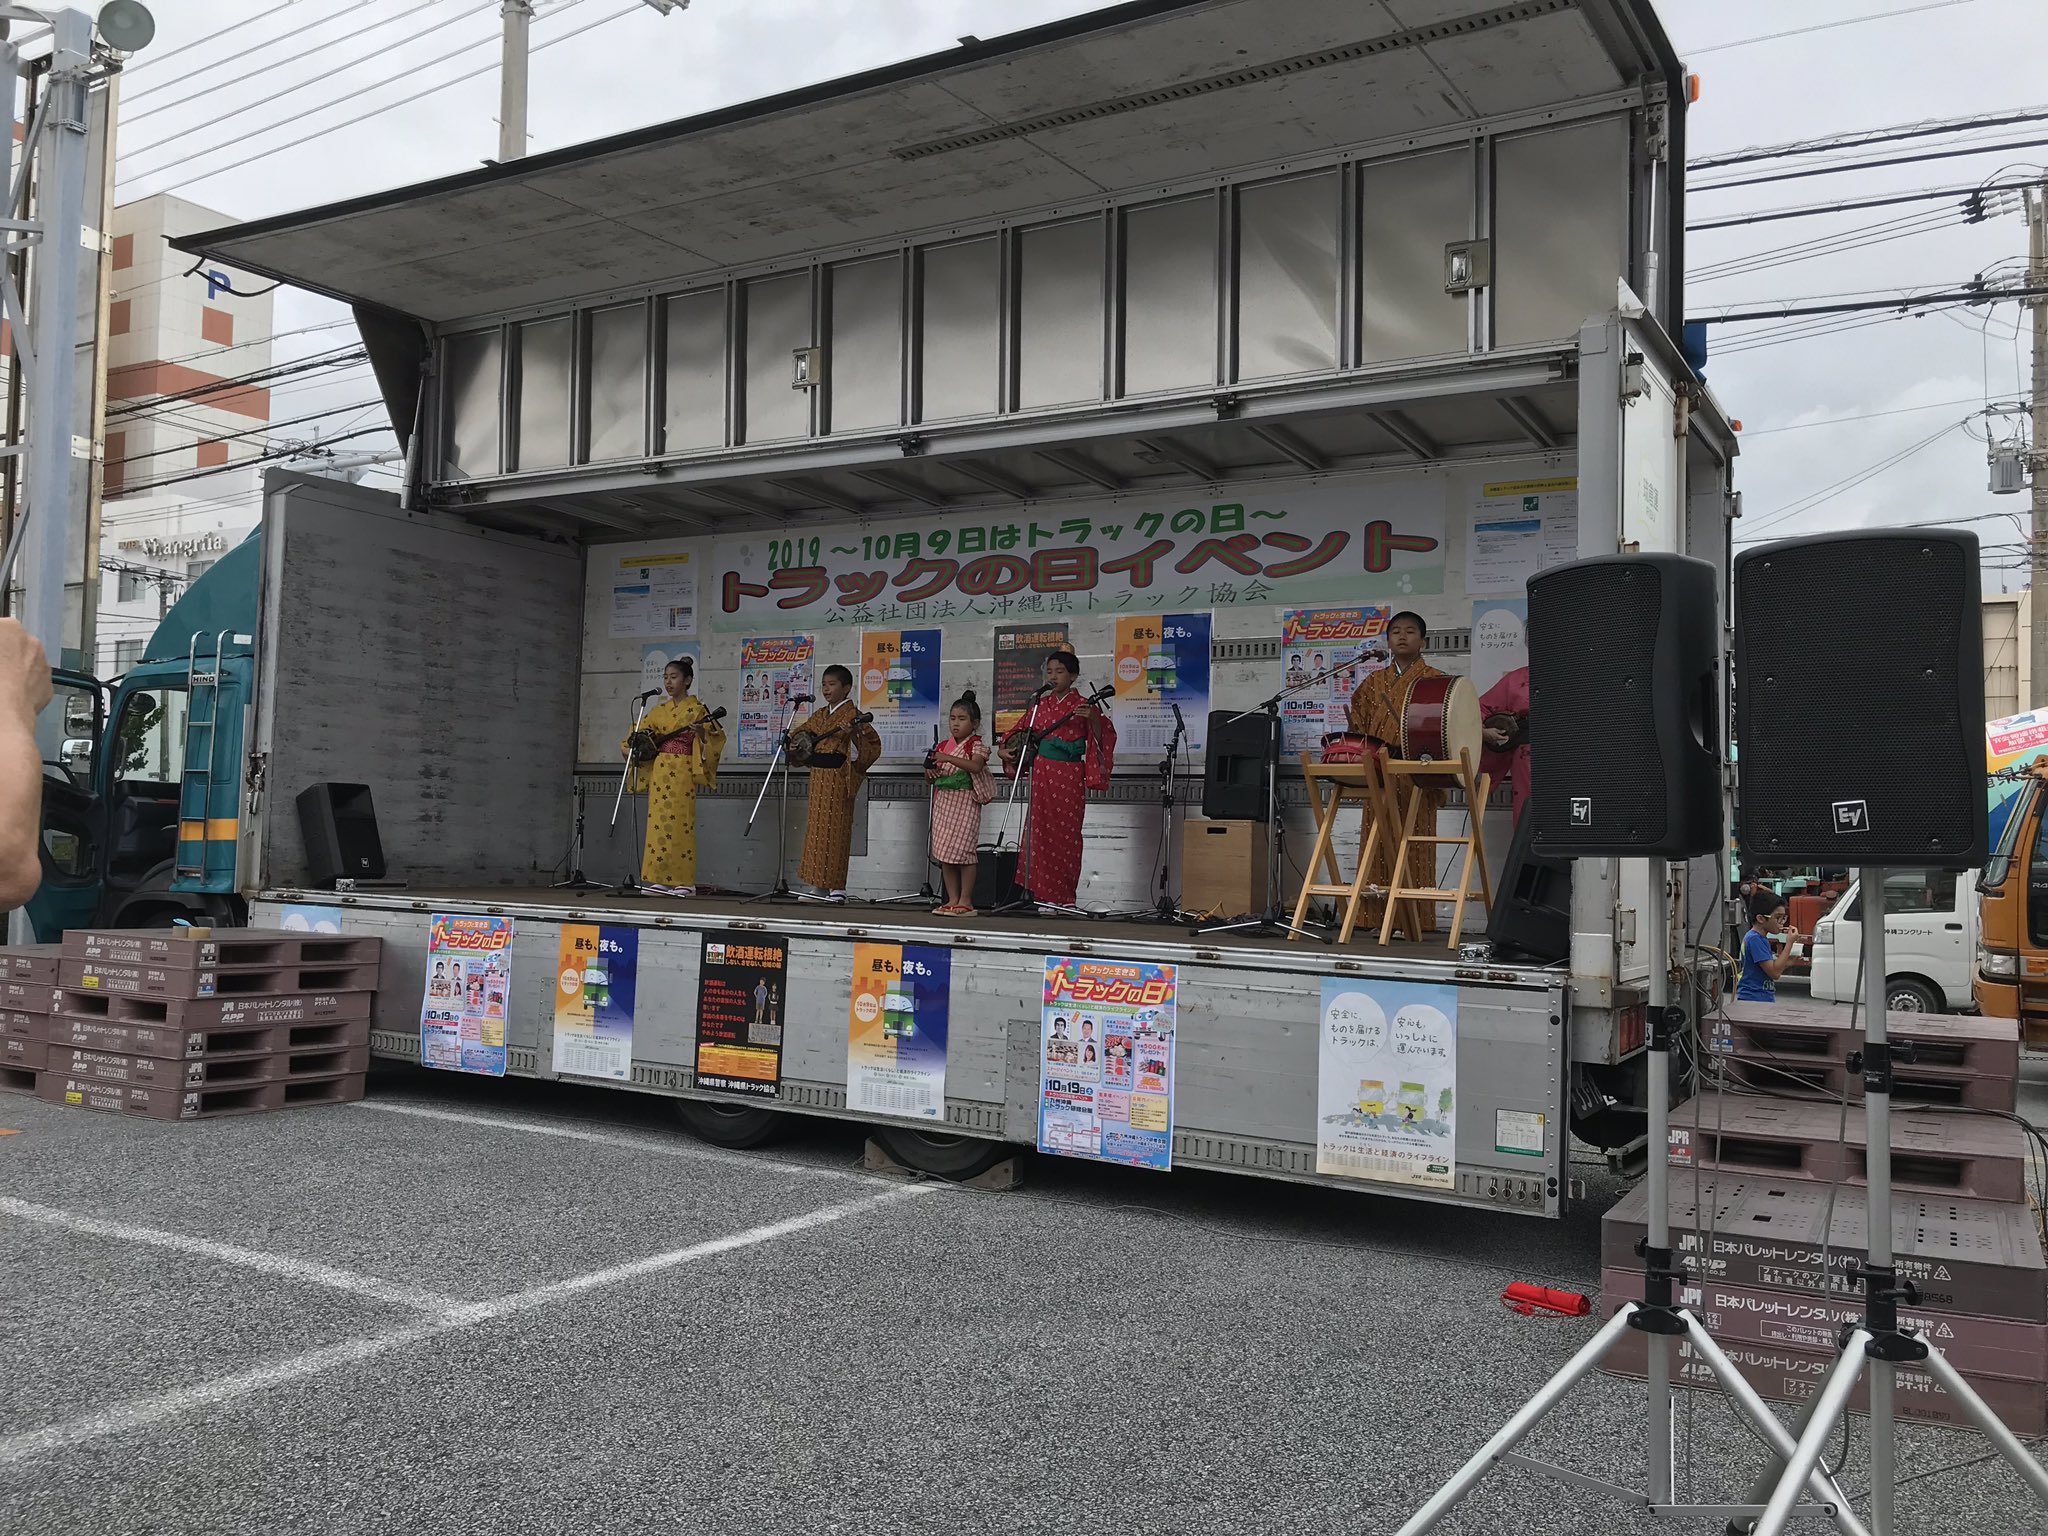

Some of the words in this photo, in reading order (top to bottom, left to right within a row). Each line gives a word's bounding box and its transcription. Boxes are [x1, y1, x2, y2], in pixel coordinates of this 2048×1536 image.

[208, 269, 231, 300] P
[768, 536, 821, 571] 2019
[722, 519, 1439, 613] トラックの日イベント
[825, 579, 1275, 624] 公益社団法人沖縄県トラック協会
[1288, 619, 1382, 640] トラックの日
[745, 645, 809, 662] トラックの日
[1574, 803, 1587, 820] EV
[1838, 808, 1861, 826] EV
[435, 926, 507, 949] トラックの日
[575, 938, 623, 954] 昼も、夜も。
[872, 959, 932, 977] 昼も、夜も。
[1052, 973, 1168, 1004] トラックの日
[1331, 1024, 1381, 1035] ものを届ける
[1395, 1033, 1438, 1043] いっしょに
[1397, 1043, 1447, 1058] 運んでいます。
[1668, 1130, 1689, 1145] JPR
[1895, 1268, 1929, 1280] PT-11
[1895, 1371, 1933, 1385] 所有物件
[1896, 1380, 1929, 1393] PT-11
